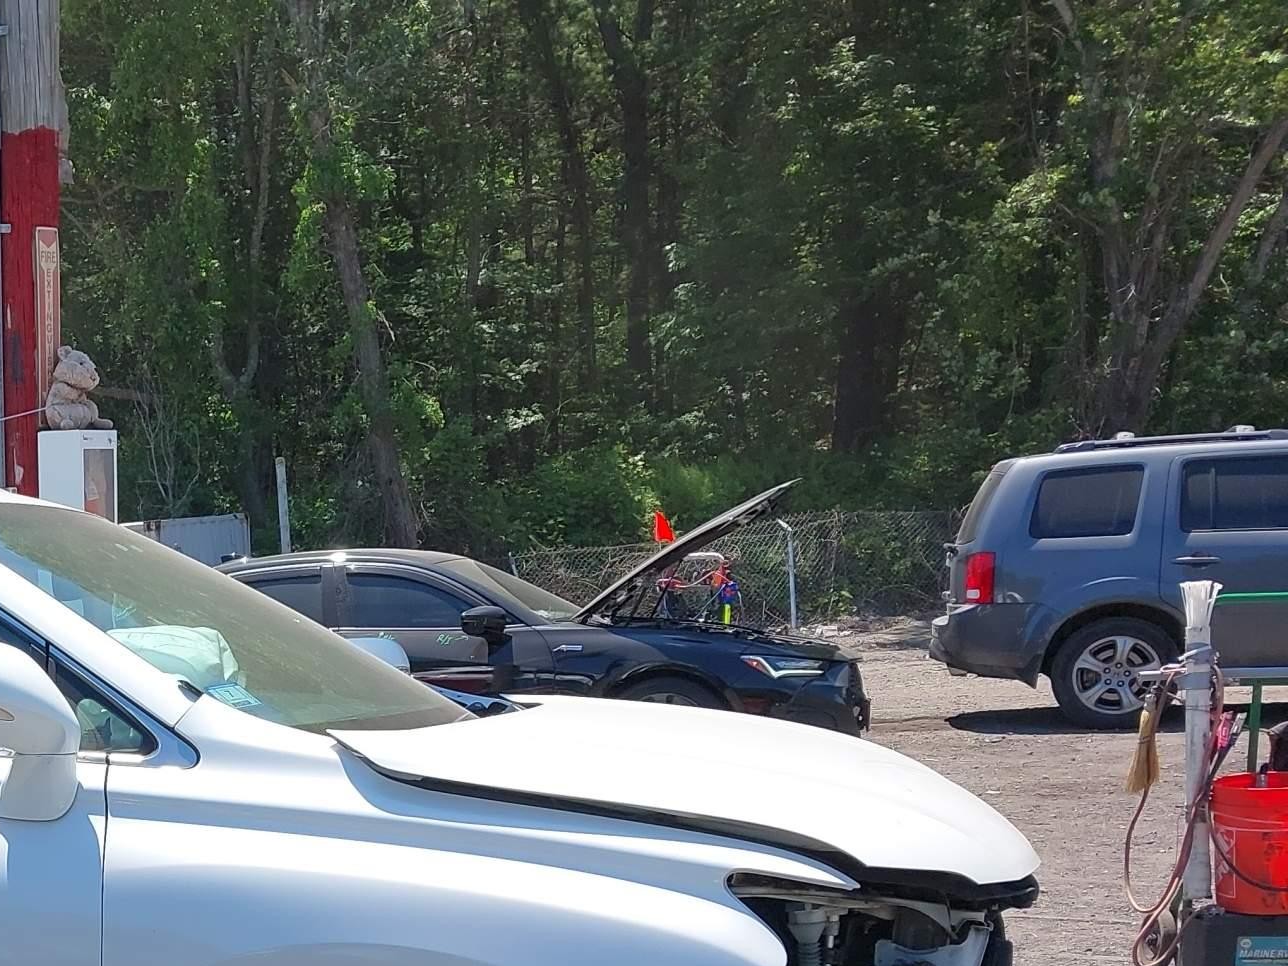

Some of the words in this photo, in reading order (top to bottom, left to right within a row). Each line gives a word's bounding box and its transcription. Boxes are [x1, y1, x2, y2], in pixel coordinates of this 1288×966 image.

[40, 250, 57, 264] FIRE
[46, 268, 54, 385] EXTINGUISH
[1239, 949, 1276, 958] MARINE
